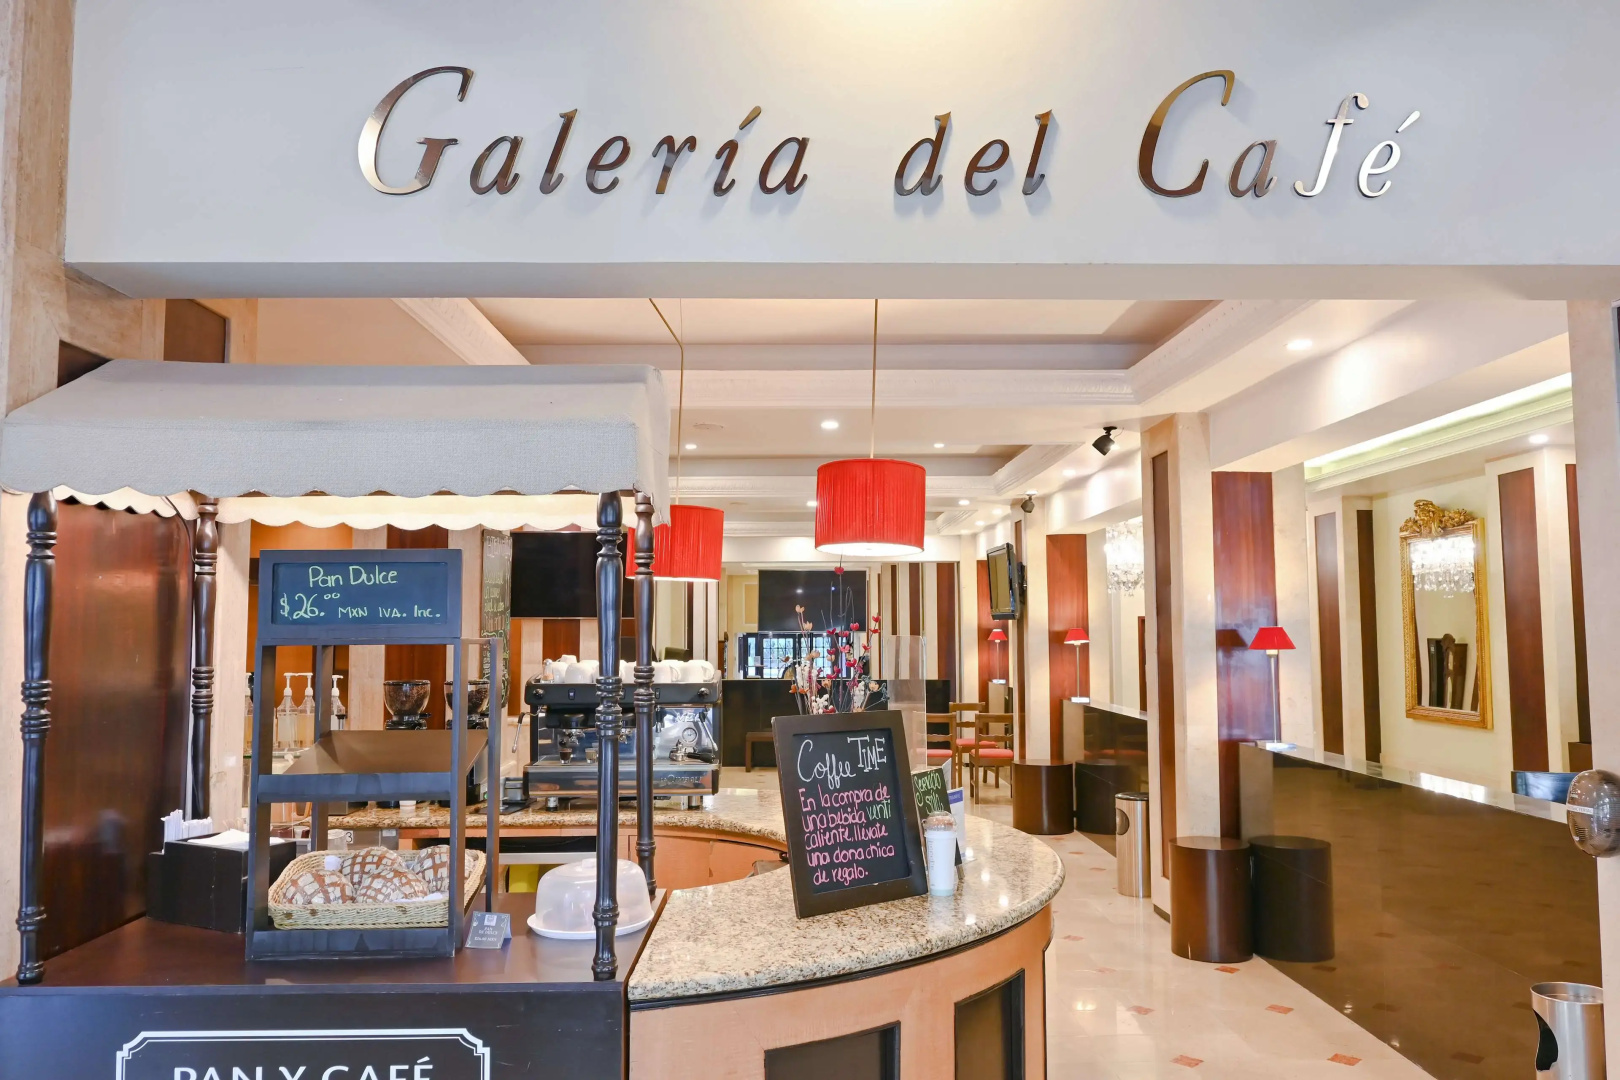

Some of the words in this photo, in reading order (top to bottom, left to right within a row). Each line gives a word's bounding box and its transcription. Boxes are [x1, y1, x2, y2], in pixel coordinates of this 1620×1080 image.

[358, 65, 810, 197] Galería
[894, 109, 1053, 197] del
[1137, 69, 1421, 199] Café
[308, 565, 343, 588] Pan
[349, 565, 398, 586] Dulce
[338, 606, 368, 618] MXN
[413, 605, 441, 618] Inc.
[797, 739, 857, 790] Coffee
[846, 734, 887, 773] TIME
[798, 788, 817, 812] En
[817, 783, 831, 808] la
[831, 788, 874, 810] compra
[874, 782, 891, 802] de
[801, 813, 827, 833] una
[827, 807, 867, 828] bebida
[865, 799, 892, 820] venti
[806, 851, 831, 868] una
[832, 846, 865, 863] dona
[865, 841, 895, 859] chica
[813, 868, 830, 886] de
[831, 863, 869, 886] regalo.
